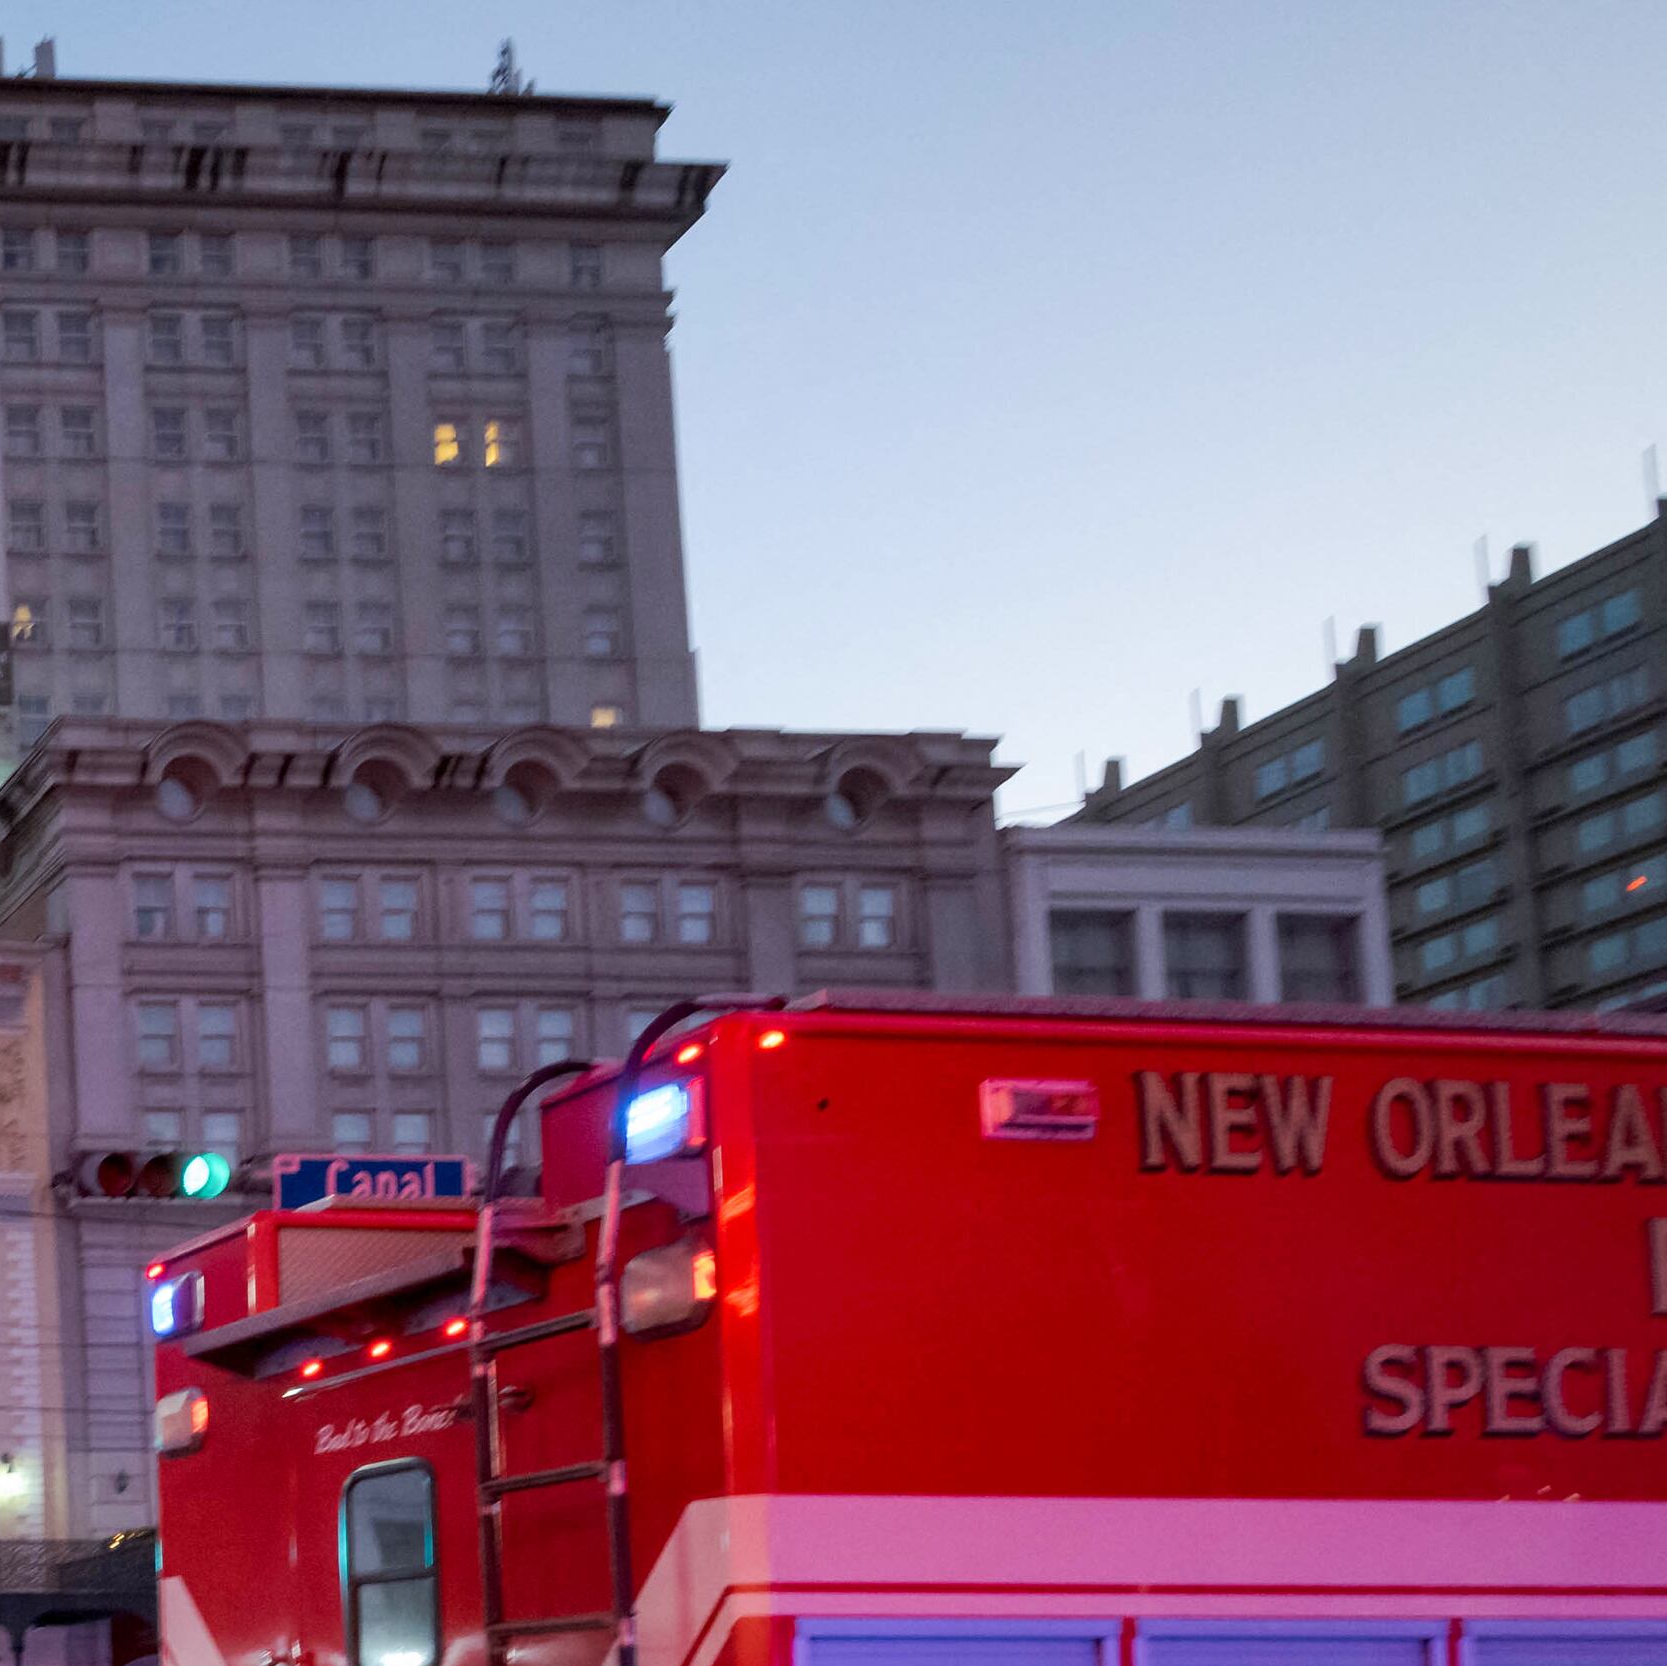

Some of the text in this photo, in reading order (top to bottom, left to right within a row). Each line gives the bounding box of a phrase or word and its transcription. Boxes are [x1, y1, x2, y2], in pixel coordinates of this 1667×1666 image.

[1137, 1070, 1667, 1182] NEW ORLEA
[325, 1158, 436, 1198] Canal
